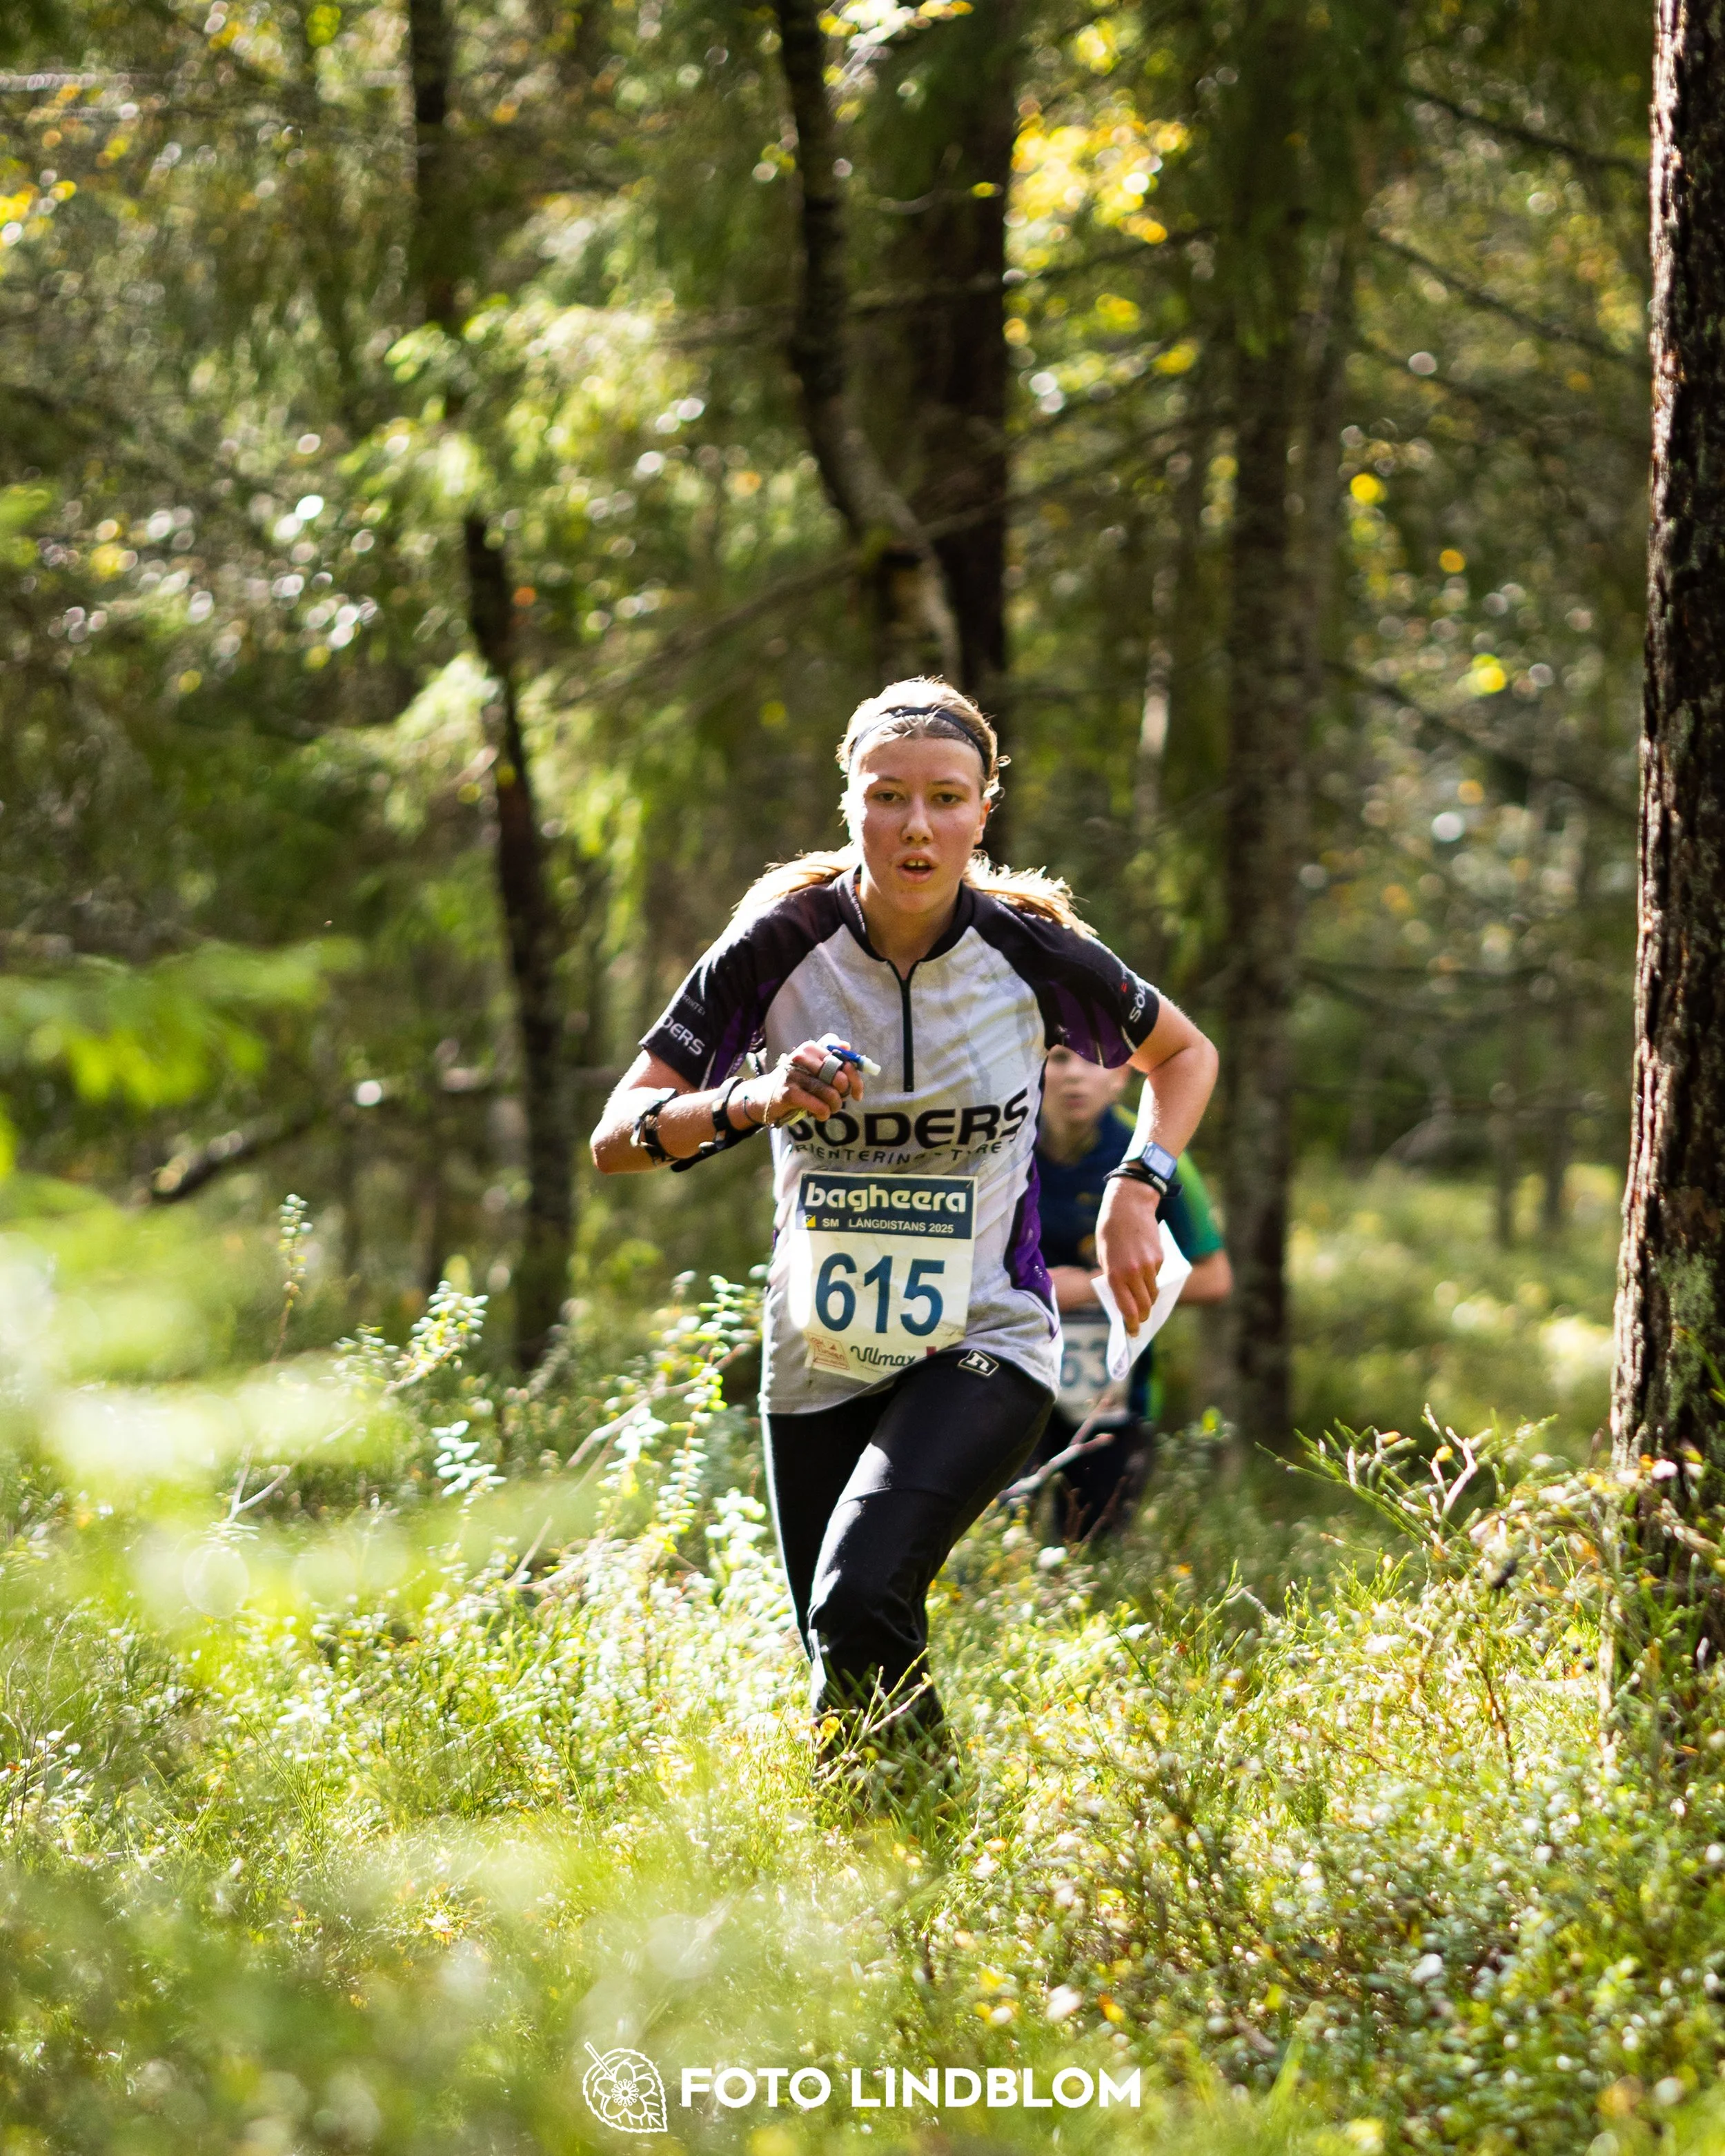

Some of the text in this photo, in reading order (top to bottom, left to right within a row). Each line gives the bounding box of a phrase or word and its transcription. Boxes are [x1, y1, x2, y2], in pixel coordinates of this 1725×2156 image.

[804, 1182, 967, 1213] bagheera
[822, 1216, 954, 1234] SM LÅNGDISTANS 2025
[815, 1252, 945, 1336] 615
